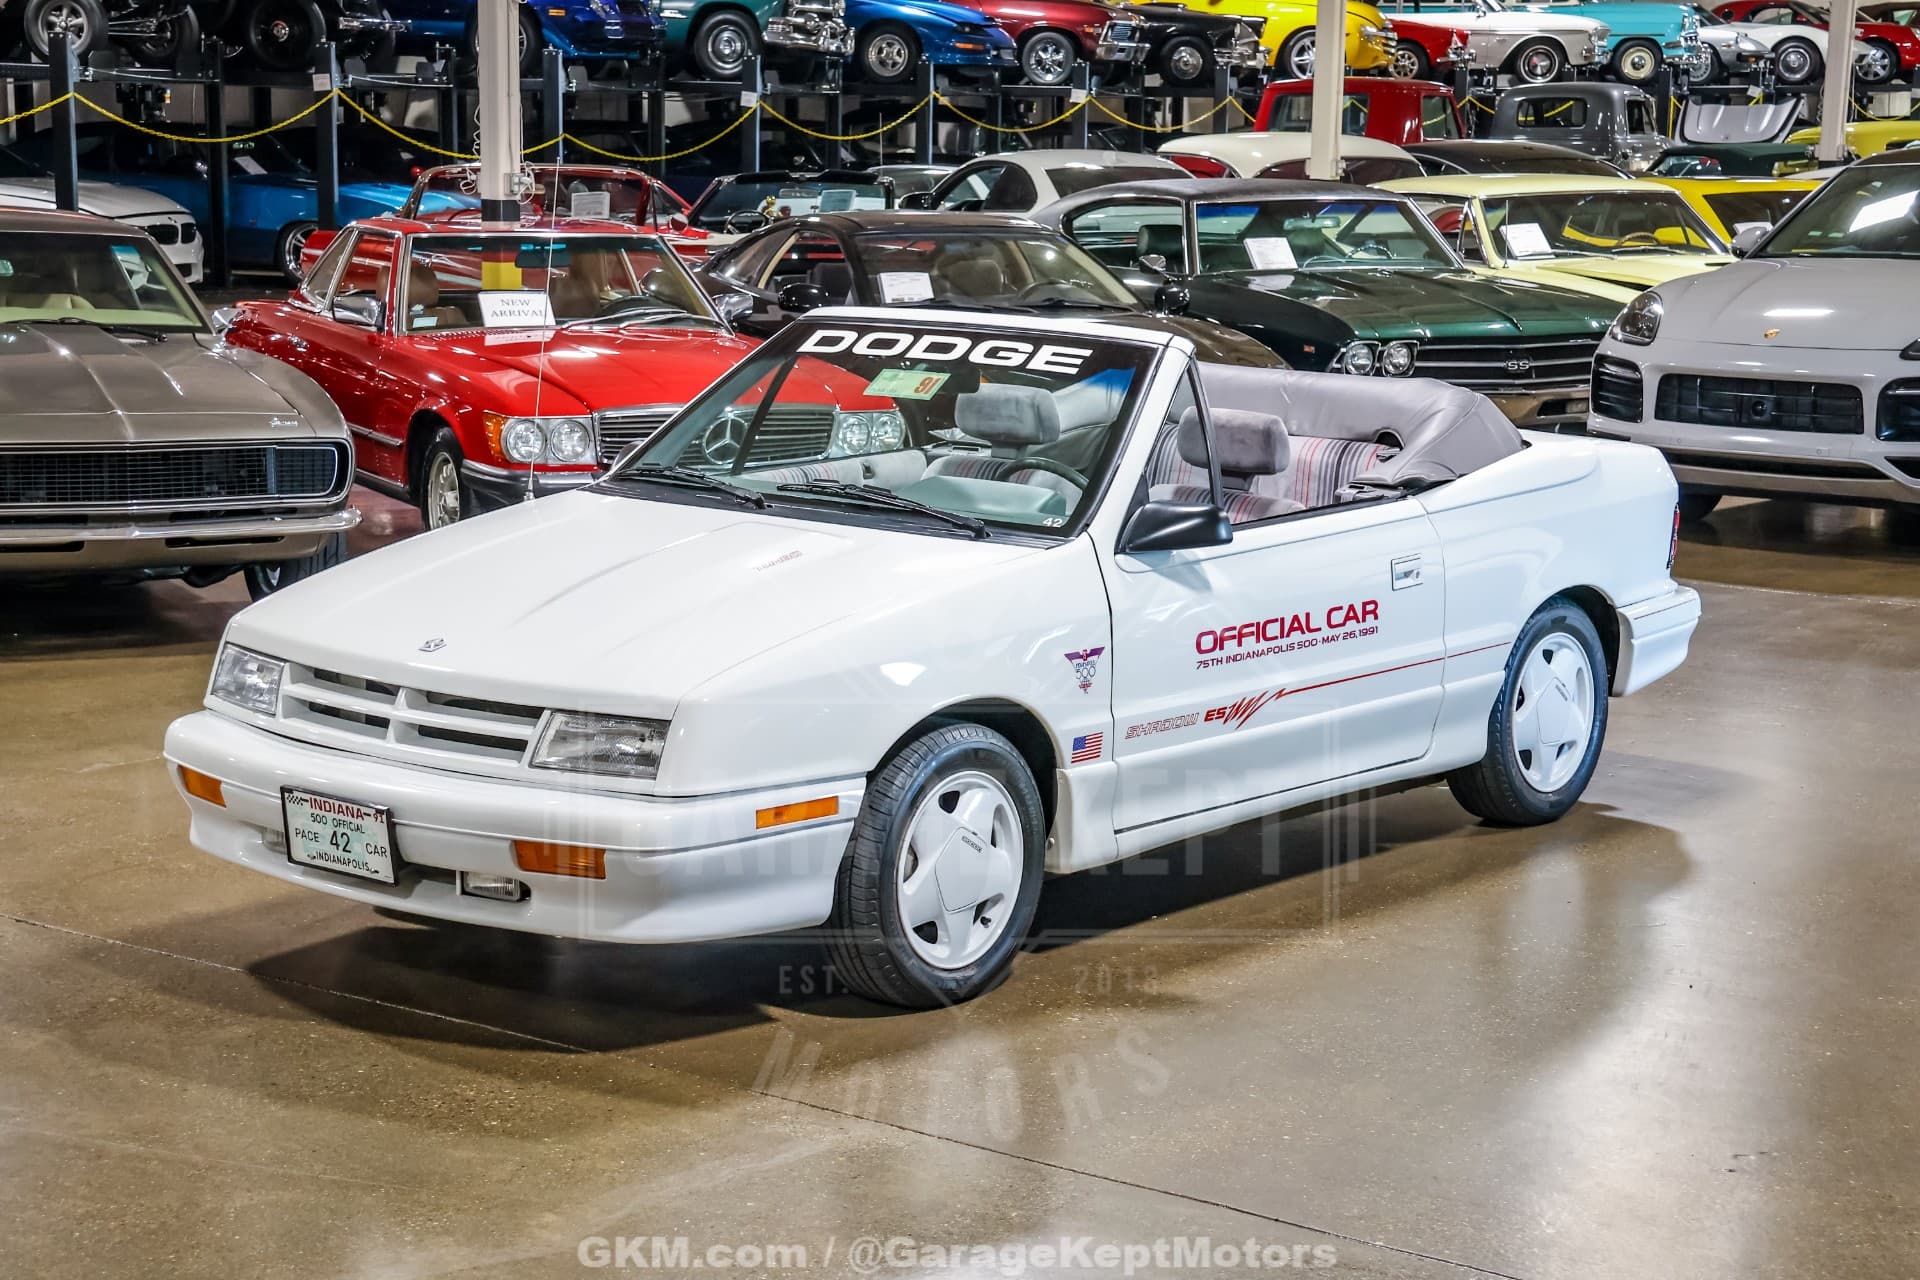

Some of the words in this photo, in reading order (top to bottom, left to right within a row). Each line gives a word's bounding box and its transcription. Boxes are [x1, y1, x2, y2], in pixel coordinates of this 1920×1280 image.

[500, 299, 530, 307] NEW
[796, 329, 1093, 375] DODGE
[1507, 360, 1530, 370] SS
[914, 376, 941, 395] 91
[1042, 517, 1063, 528] 42
[1196, 612, 1321, 655] OFFICIAL
[1326, 599, 1379, 629] CAR
[1196, 656, 1223, 669] 75TH
[1225, 643, 1295, 664] INDIANAPOLIS
[1125, 712, 1199, 740] SHADOW
[1204, 706, 1227, 722] ES
[309, 797, 365, 820] INDIANA
[373, 813, 385, 824] 91
[311, 813, 328, 825] 500
[332, 818, 366, 834] OFFICIAL
[295, 828, 320, 843] PACE
[329, 830, 352, 853] 42
[365, 842, 388, 859] CAR
[316, 851, 370, 871] INDIANAPOLIS
